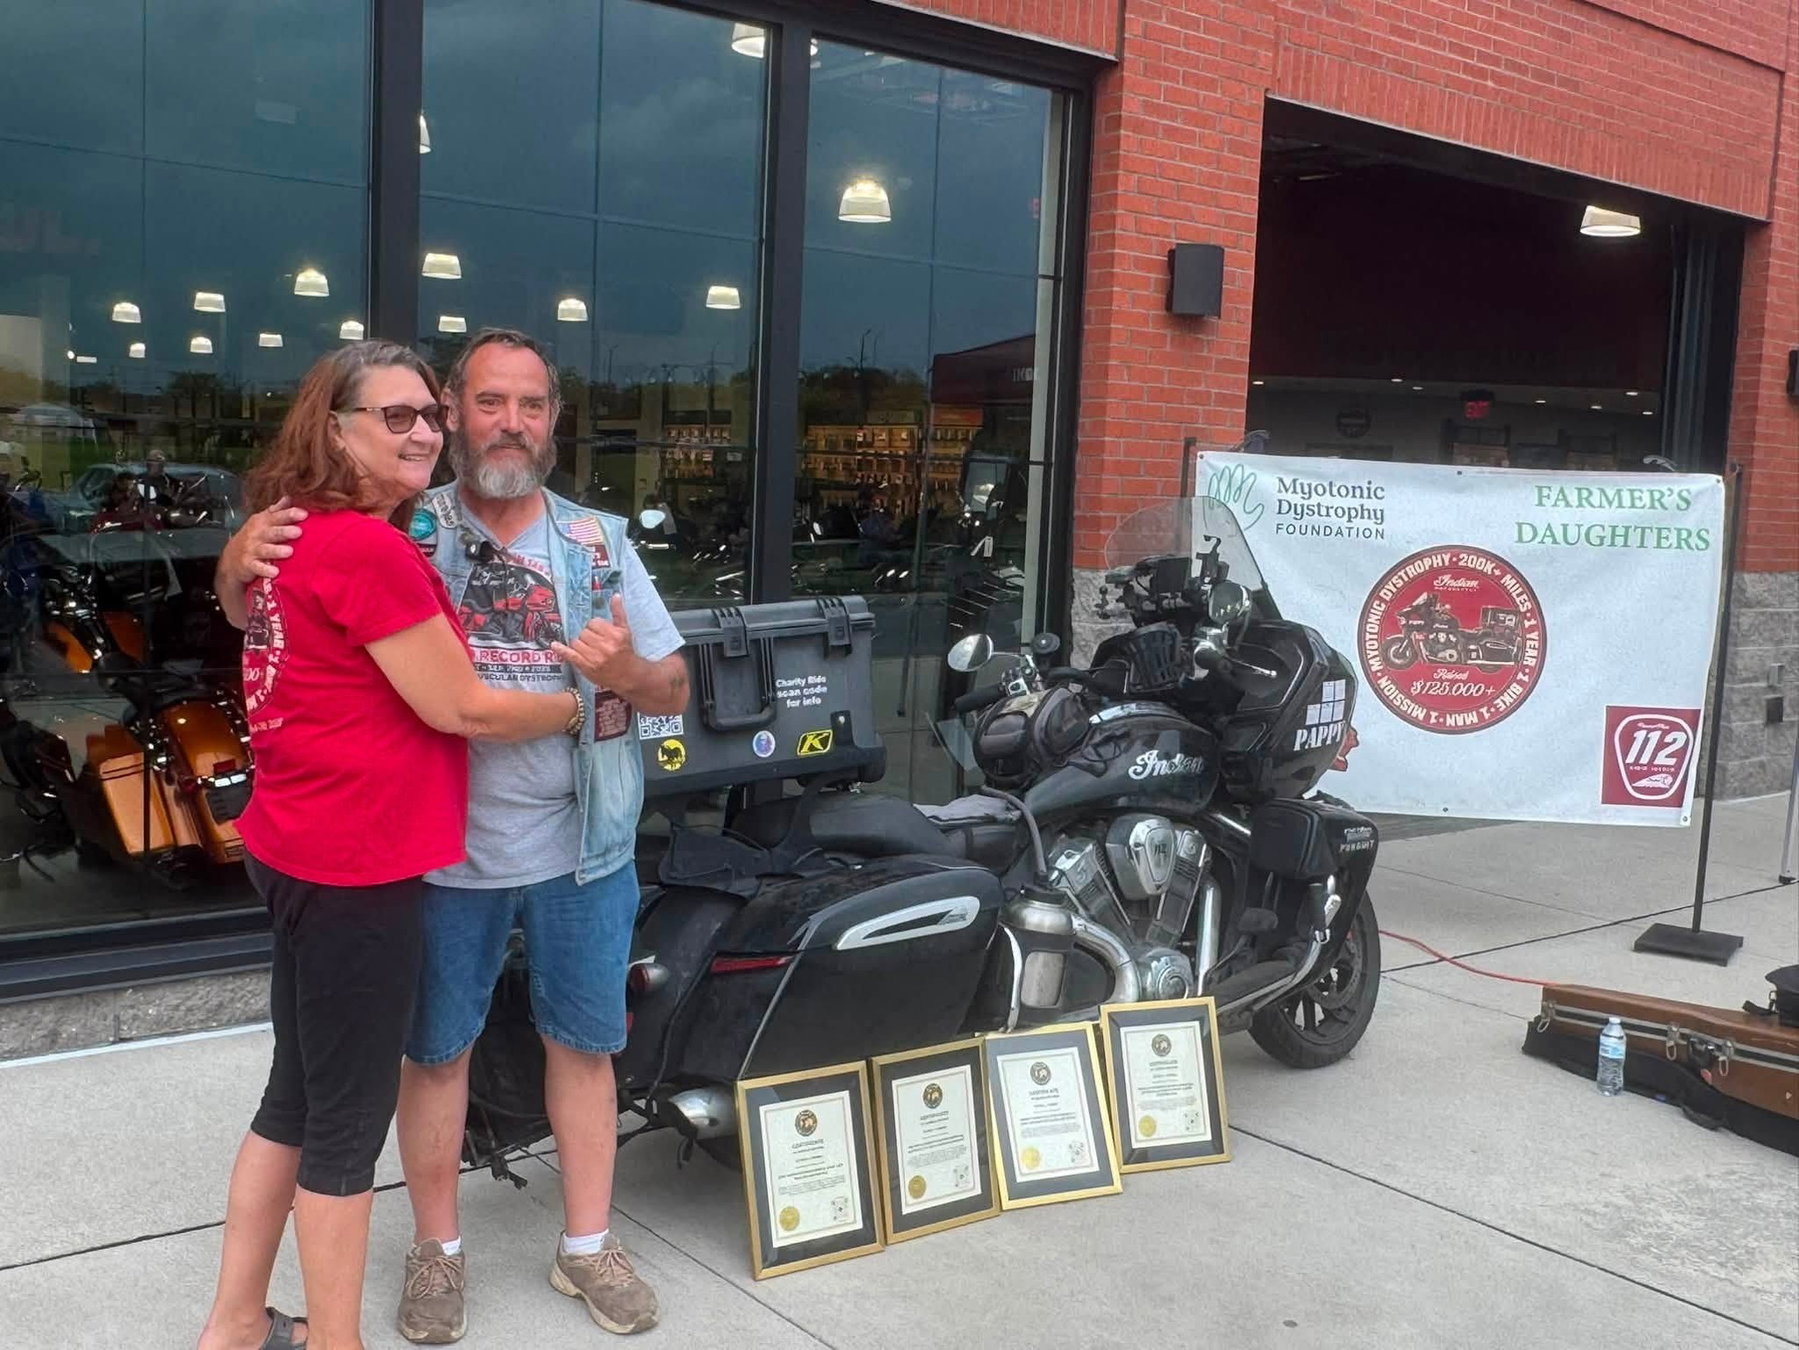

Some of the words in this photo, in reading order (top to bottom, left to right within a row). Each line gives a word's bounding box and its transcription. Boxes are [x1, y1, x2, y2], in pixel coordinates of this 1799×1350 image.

[1276, 477, 1385, 500] Myotonic
[1535, 485, 1692, 511] FARMER'S
[1276, 499, 1385, 525] Dystrophy
[1276, 523, 1385, 539] FOUNDATION
[1515, 522, 1710, 551] DAUGHTERS
[1379, 553, 1451, 602] DYSTROPHY
[1433, 574, 1479, 587] Indian
[1500, 574, 1531, 612] MILES
[269, 613, 285, 648] YEAR
[1366, 600, 1387, 673] MYOTONIC
[480, 650, 541, 664] RECORD
[1523, 632, 1539, 666] YEAR
[1433, 668, 1470, 680] Raised
[787, 699, 800, 708] for
[803, 696, 822, 706] info
[1377, 676, 1427, 720] MISSION
[1494, 684, 1523, 712] BIKE
[1446, 710, 1479, 727] MAN
[1293, 720, 1346, 751] PAPPY
[1625, 729, 1688, 766] 112
[1128, 749, 1205, 780] Indian
